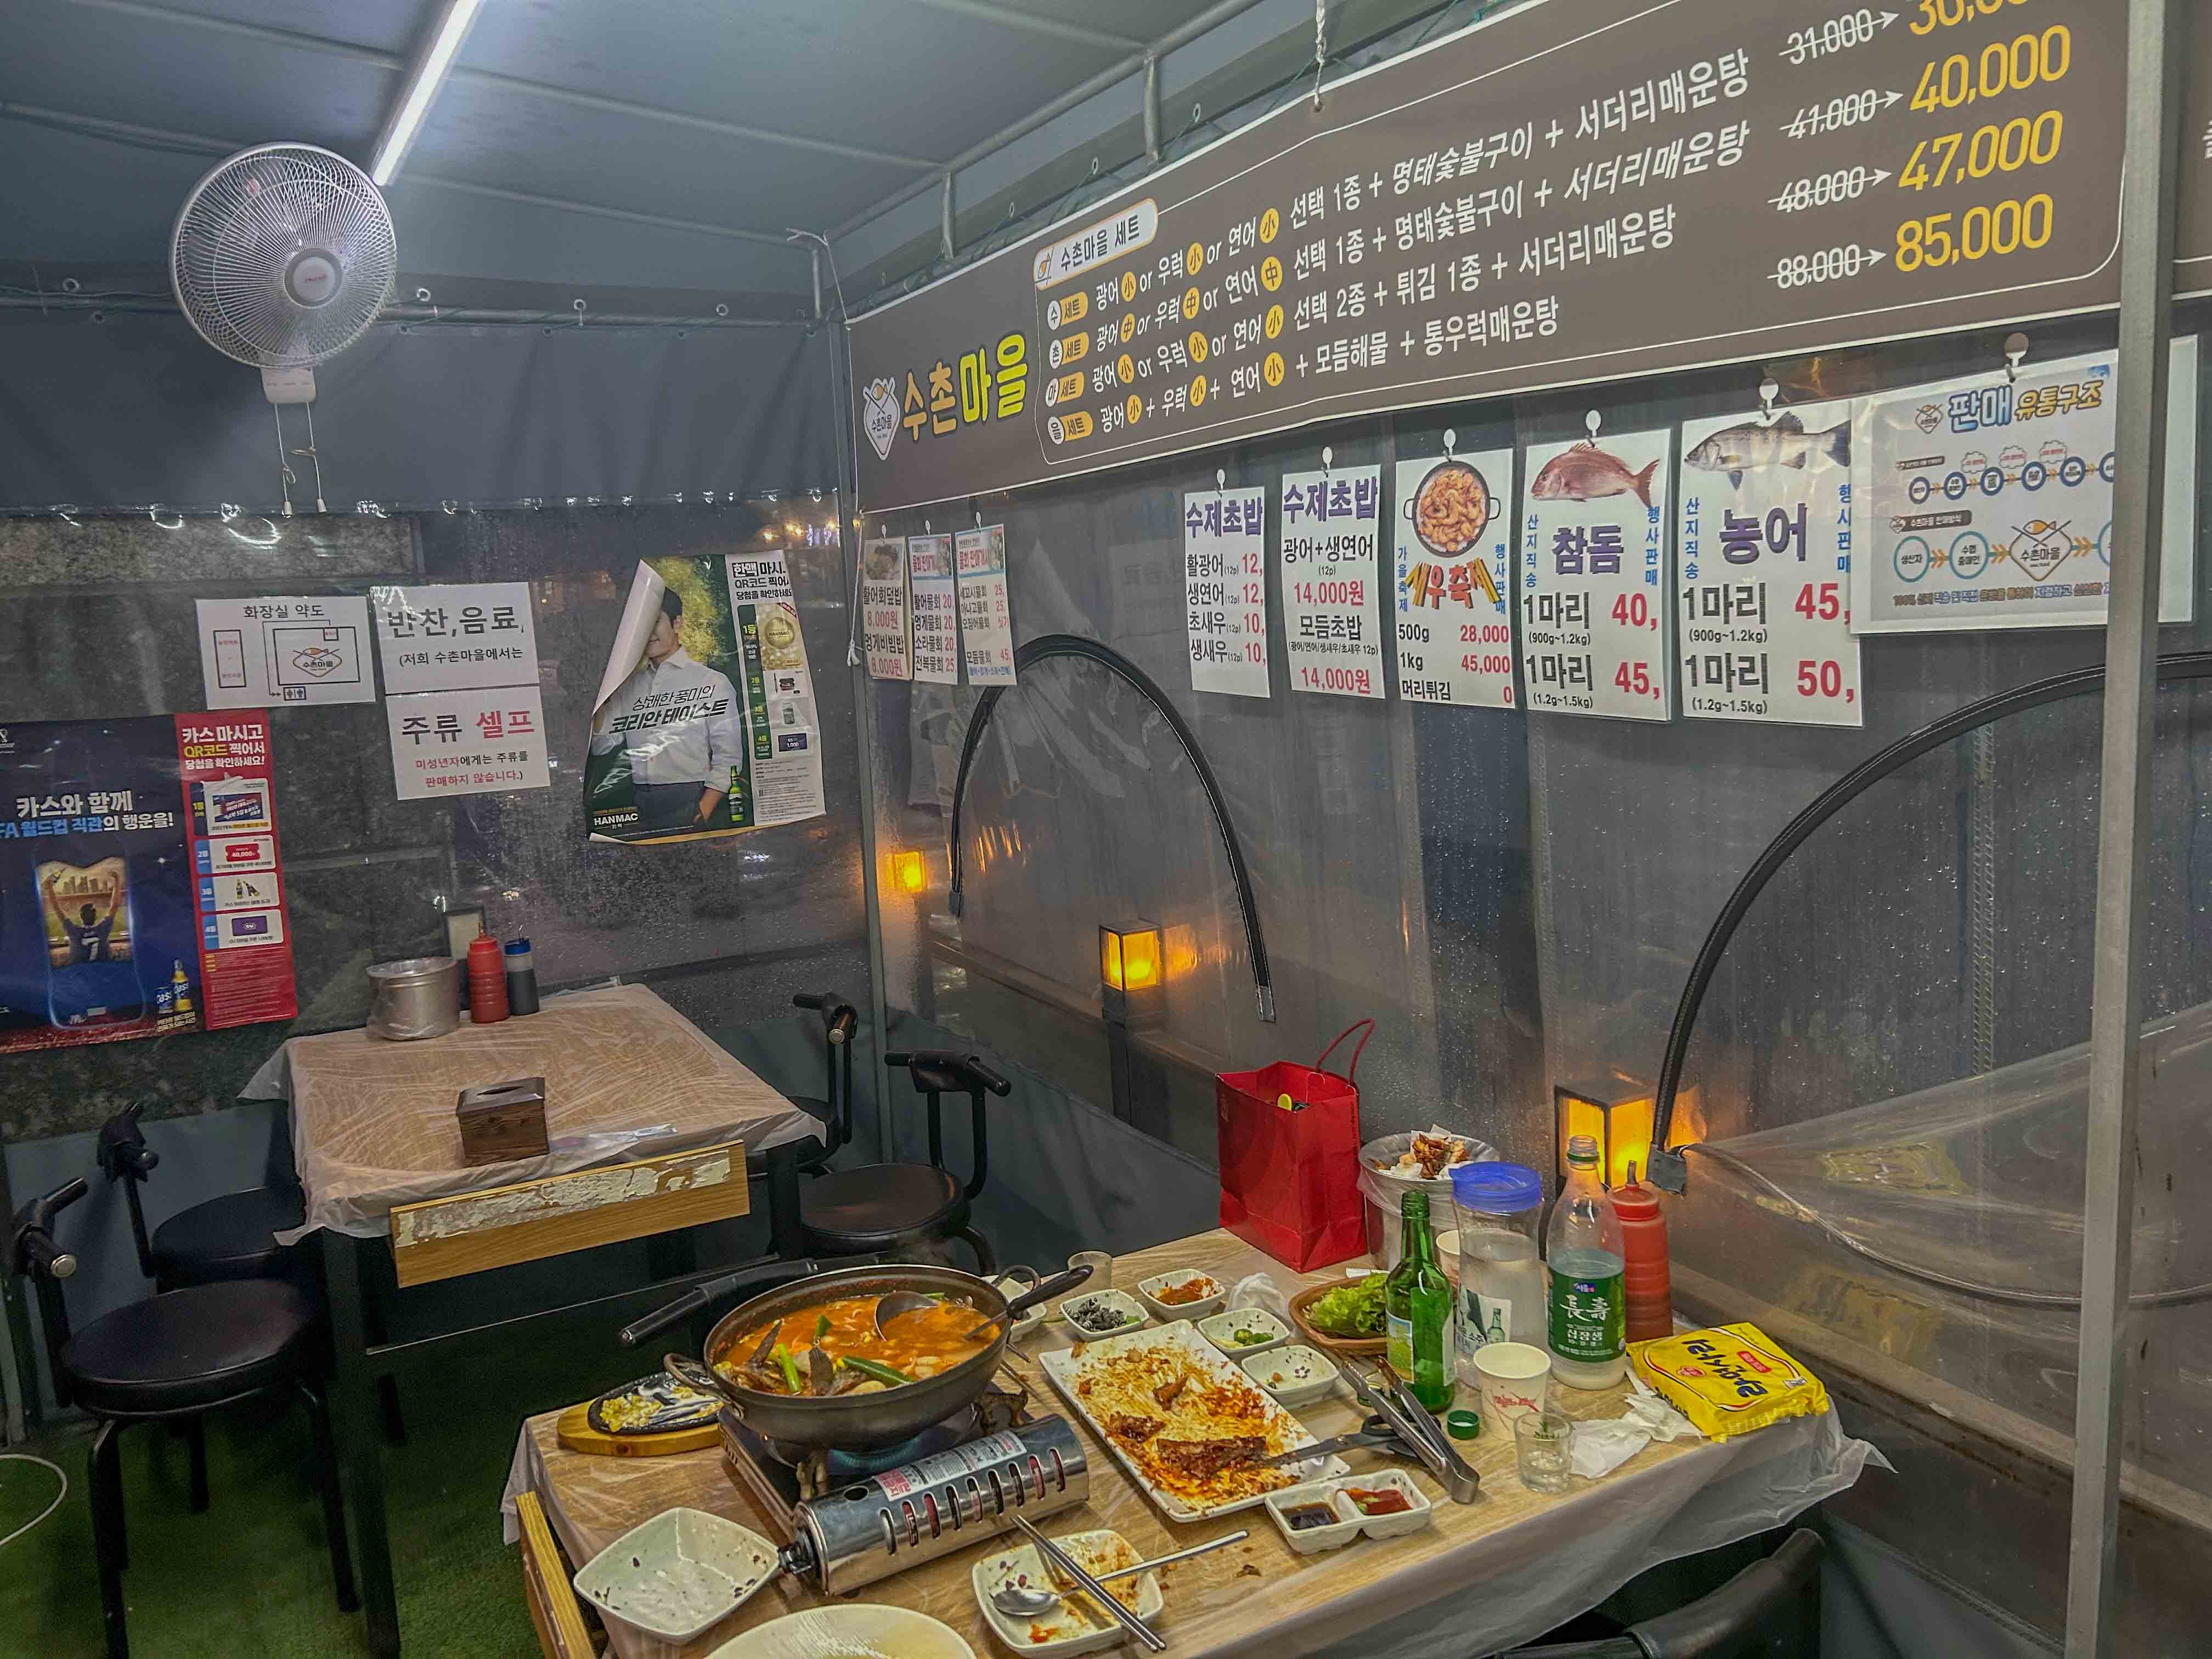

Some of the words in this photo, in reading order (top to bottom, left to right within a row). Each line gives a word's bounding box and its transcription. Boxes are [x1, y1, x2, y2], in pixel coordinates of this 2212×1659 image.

[1787, 9, 1873, 65] 31,000
[1064, 297, 1080, 318] 세트
[1096, 279, 1118, 312] 광어
[1139, 273, 1152, 291] or
[1158, 254, 1184, 285] 우럭
[1207, 243, 1222, 264] or
[1228, 217, 1257, 256] 연어
[1291, 175, 1325, 229] 선택
[1334, 175, 1361, 213] 1종
[1393, 122, 1533, 196] 명태숯불구이
[1575, 49, 1749, 143] 서더리매운탕
[1065, 338, 1081, 359] 세트
[1097, 320, 1119, 352] 광어
[1137, 315, 1150, 335] or
[1155, 298, 1181, 330] 우럭
[1204, 289, 1219, 311] or
[1225, 265, 1259, 304] 연어
[1293, 227, 1327, 281] 선택
[1336, 229, 1364, 269] 1종
[1395, 180, 1523, 253] 명태숯불구이
[1564, 121, 1750, 202] 서더리매운탕
[1788, 89, 1877, 140] 41,000
[1909, 24, 2072, 114] 40,000
[1060, 229, 1108, 271] 수촌마을
[1114, 215, 1140, 246] 세트
[1060, 378, 1076, 398] 세트
[1092, 360, 1118, 394] 광어
[1138, 357, 1152, 377] or
[1157, 345, 1187, 375] 우럭
[1212, 335, 1227, 356] or
[1233, 314, 1261, 353] 연어
[1294, 281, 1328, 332] 선택
[1337, 283, 1365, 320] 2종
[1397, 262, 1436, 306] 튀김
[1448, 253, 1480, 294] 1종
[1519, 203, 1676, 278] 서더리매운탕
[1777, 166, 1865, 213] 48,000
[1898, 110, 2063, 191] 47,000
[1068, 417, 1085, 435] 세트
[1101, 401, 1124, 434] 광어
[1162, 387, 1187, 418] 우럭
[1232, 359, 1260, 399] 연어
[1316, 331, 1388, 376] 모듬해물
[1424, 295, 1559, 357] 통우럭매운탕
[1777, 244, 1860, 289] 88,000
[1895, 193, 2053, 273] 85,000
[902, 333, 1029, 441] 수촌마을
[1948, 385, 2013, 433] 판매
[2015, 380, 2104, 421] 유통구조
[872, 415, 891, 431] 수촌마을
[1283, 476, 1378, 523] 수제초밥
[1186, 496, 1262, 538] 수제초밥
[1645, 506, 1660, 586] 행사판매
[1685, 496, 1700, 580] 산지직송
[1719, 503, 1807, 565] 농어
[1526, 514, 1539, 588] 산지직송
[1553, 524, 1624, 575] 참돔
[2020, 547, 2060, 562] 수촌마을
[733, 563, 758, 577] 한맥
[1242, 553, 1263, 576] 12,
[1318, 566, 1336, 576] (12p)
[735, 577, 767, 589] QR코드
[736, 590, 759, 600] 당첨을
[1243, 583, 1264, 607] 12,
[1294, 580, 1364, 606] 14,000원
[864, 586, 902, 606] 활어회덮밥
[1682, 582, 1767, 625] 1마리
[1795, 583, 1851, 625] 45,
[243, 605, 289, 619] 화장실
[295, 603, 325, 618] 약도
[1523, 592, 1590, 629] 1마리
[1611, 593, 1658, 630] 40,
[1244, 613, 1265, 636] 10,
[1300, 614, 1362, 641] 모듬초밥
[1398, 624, 1430, 642] 500g
[1460, 625, 1509, 645] 28,000
[1689, 628, 1768, 644] (900g~1.2kg)
[865, 633, 904, 654] 멍게비빔밥
[1528, 632, 1591, 646] (900g~1.2kg)
[399, 650, 430, 667] (저희
[434, 646, 523, 665] 수촌마을에서는
[1245, 642, 1266, 665] 10,
[1400, 652, 1423, 671] 1kg
[1461, 656, 1510, 675] 45,000
[1301, 667, 1371, 695] 14,000원
[1526, 653, 1594, 691] 1마리
[1615, 662, 1660, 699] 45,
[1685, 653, 1769, 695] 1마리
[1797, 660, 1854, 703] 50,
[633, 692, 675, 712] 상쾌한
[674, 685, 716, 704] 풍미의
[1402, 680, 1451, 701] 머리튀김
[1503, 686, 1512, 703] 0
[1533, 693, 1593, 709] (1.2g~1.5kg)
[609, 710, 663, 733] 코리안
[662, 698, 729, 725] 테이스트
[1691, 698, 1768, 714] (1.2g~1.5kg)
[182, 727, 215, 743] 카스
[216, 724, 264, 742] 마시고
[401, 714, 463, 746] 주류
[475, 709, 536, 740] 셀프
[184, 744, 228, 758] QR코드
[229, 742, 265, 755] 찍어서
[416, 753, 492, 770] 미성년자에게는
[496, 751, 529, 766] 주류를
[185, 758, 215, 770] 당첨을
[425, 773, 470, 788] 판매하지
[16, 793, 83, 818] 카스와
[87, 790, 133, 814] 함께
[21, 818, 68, 837] 월드컵
[122, 812, 174, 831] 행운을!
[594, 813, 639, 826] HANMAC
[1559, 1294, 1611, 1322] 長壽
